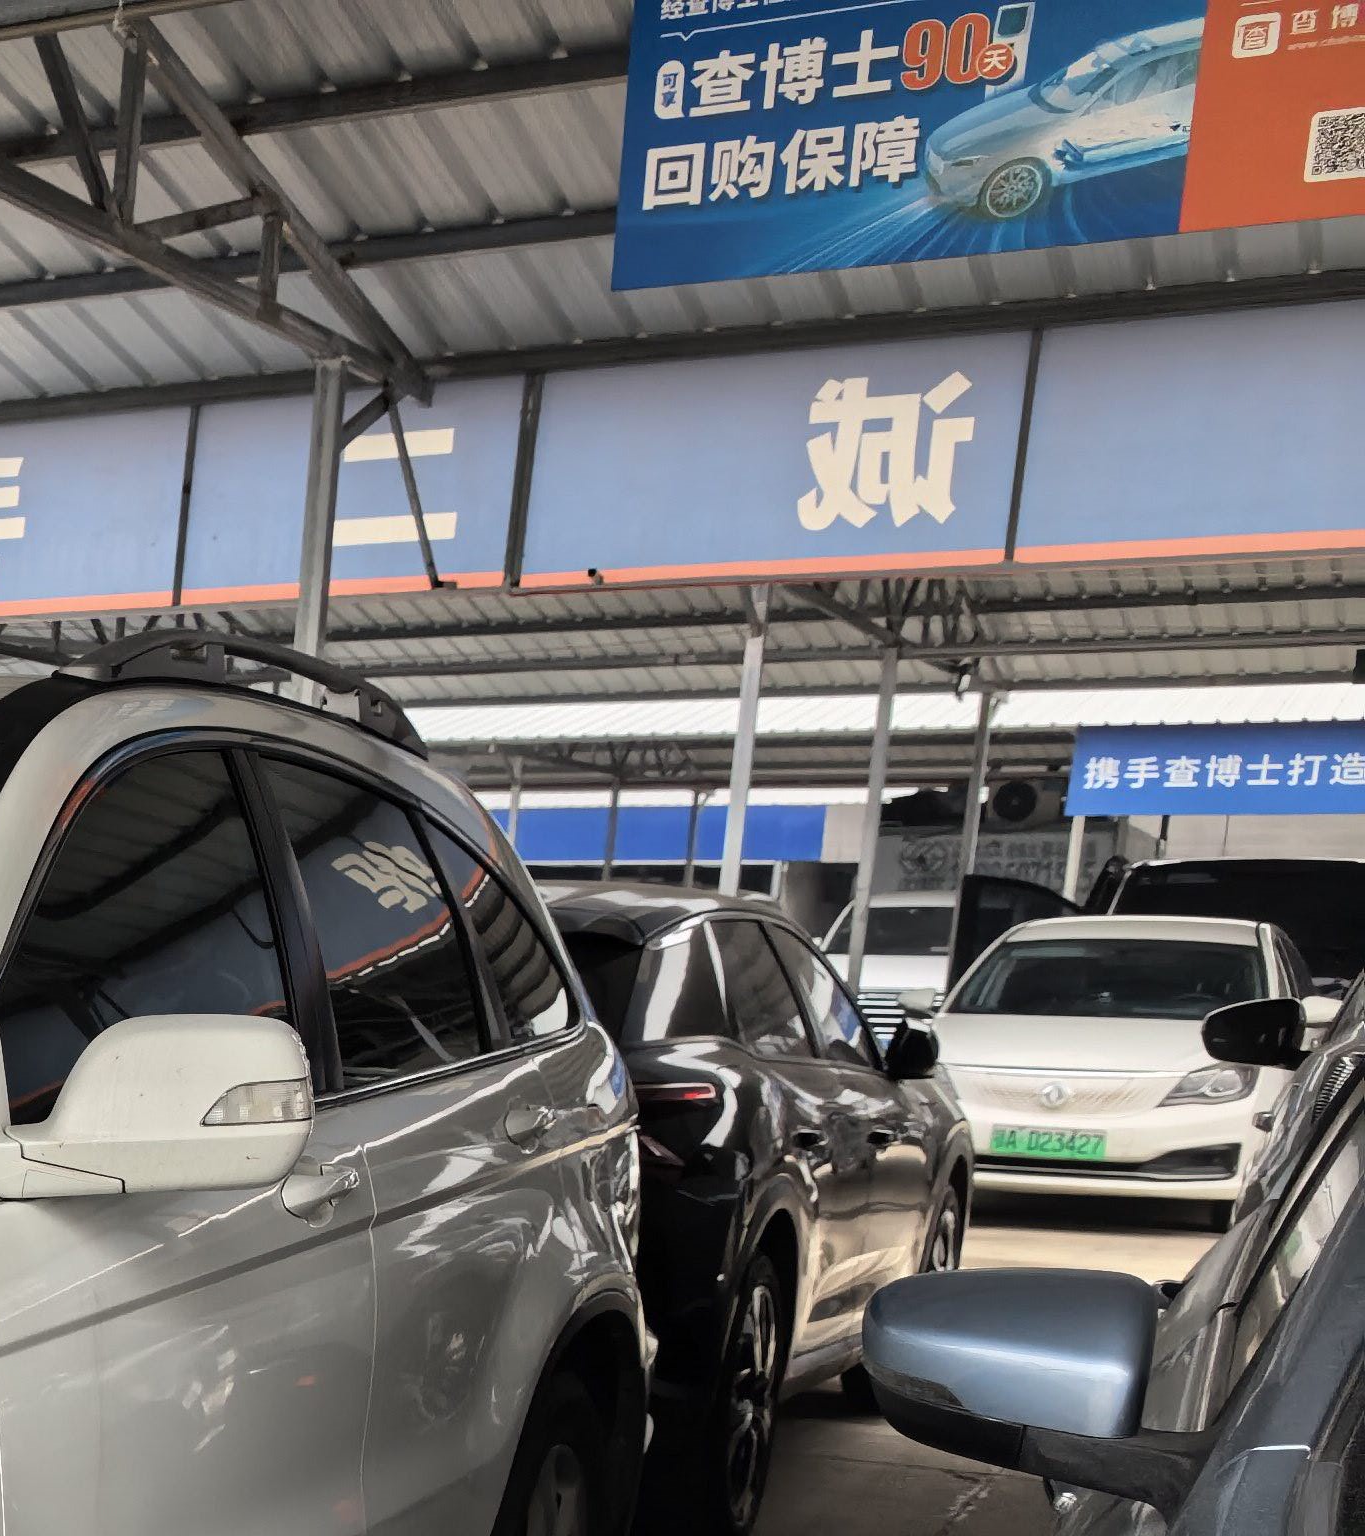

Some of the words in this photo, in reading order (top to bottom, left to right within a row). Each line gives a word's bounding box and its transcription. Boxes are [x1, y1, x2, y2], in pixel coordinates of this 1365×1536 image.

[642, 114, 922, 211] 回购保障
[1082, 751, 1365, 790] 携手查博士打造
